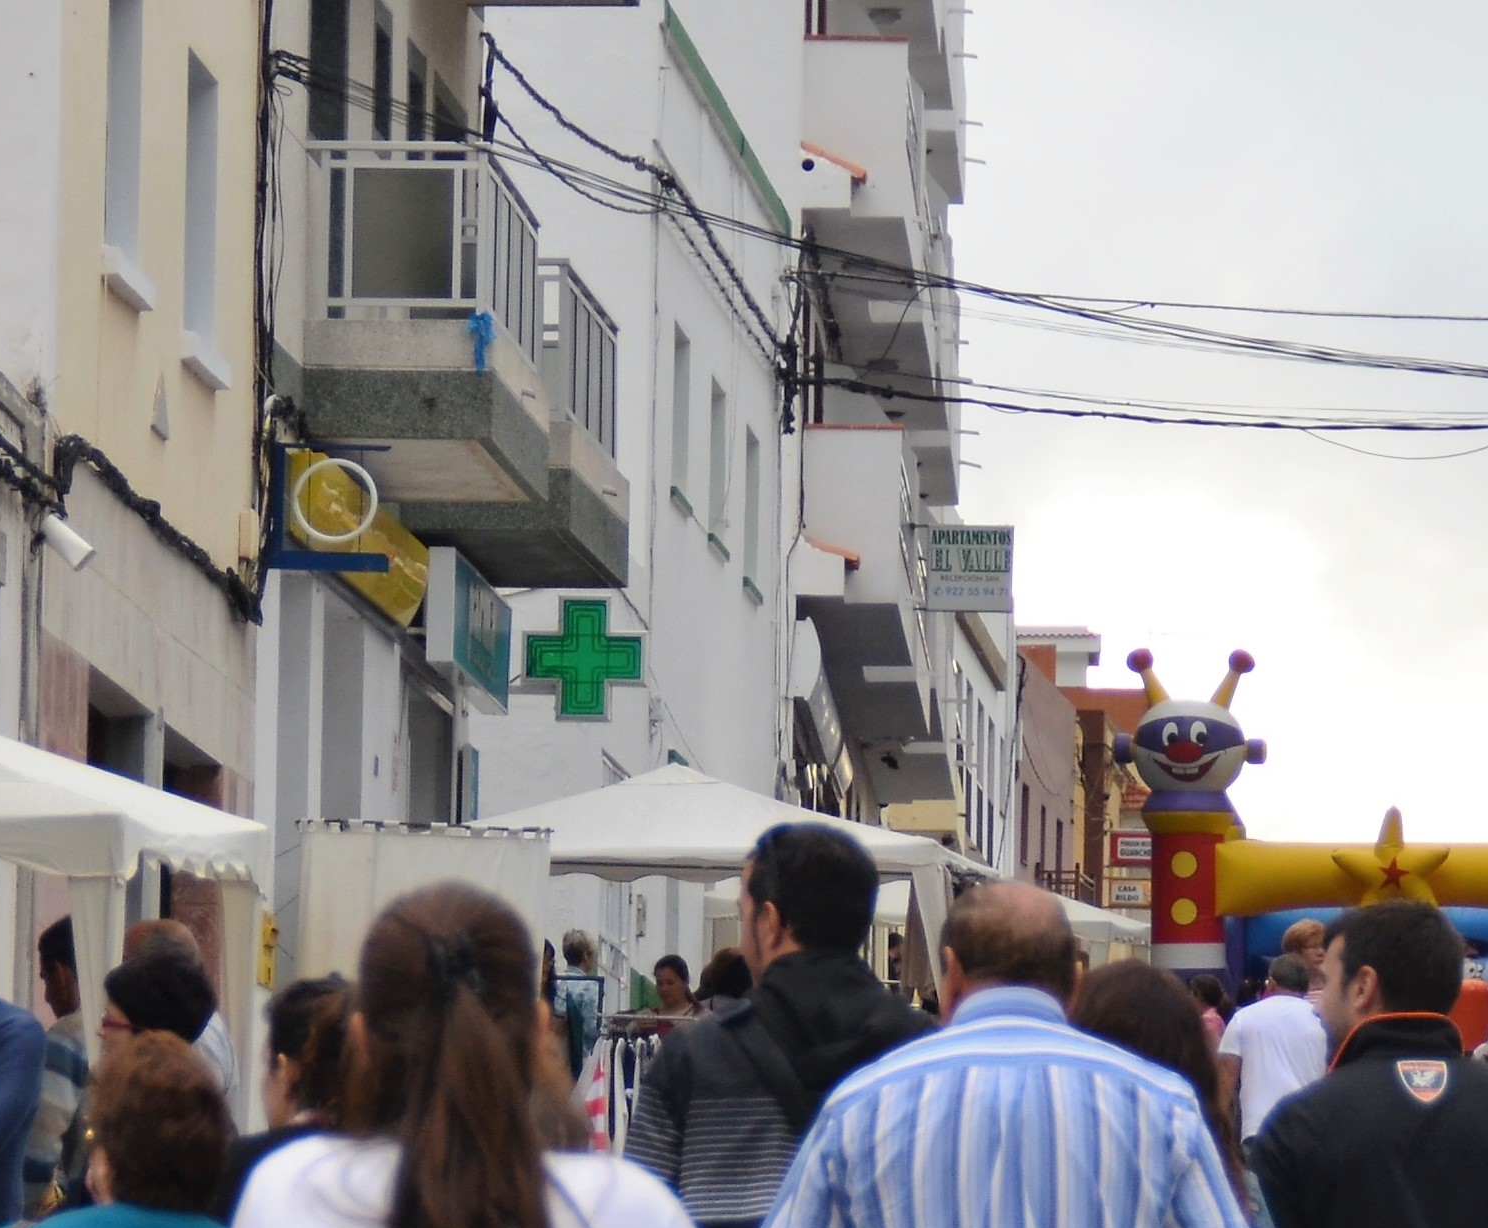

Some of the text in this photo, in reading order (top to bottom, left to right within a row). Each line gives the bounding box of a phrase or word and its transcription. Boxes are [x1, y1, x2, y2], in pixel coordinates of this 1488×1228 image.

[931, 530, 1011, 545] APARTAMENTOS
[930, 548, 1012, 573] EL VALLE
[945, 586, 964, 597] 922
